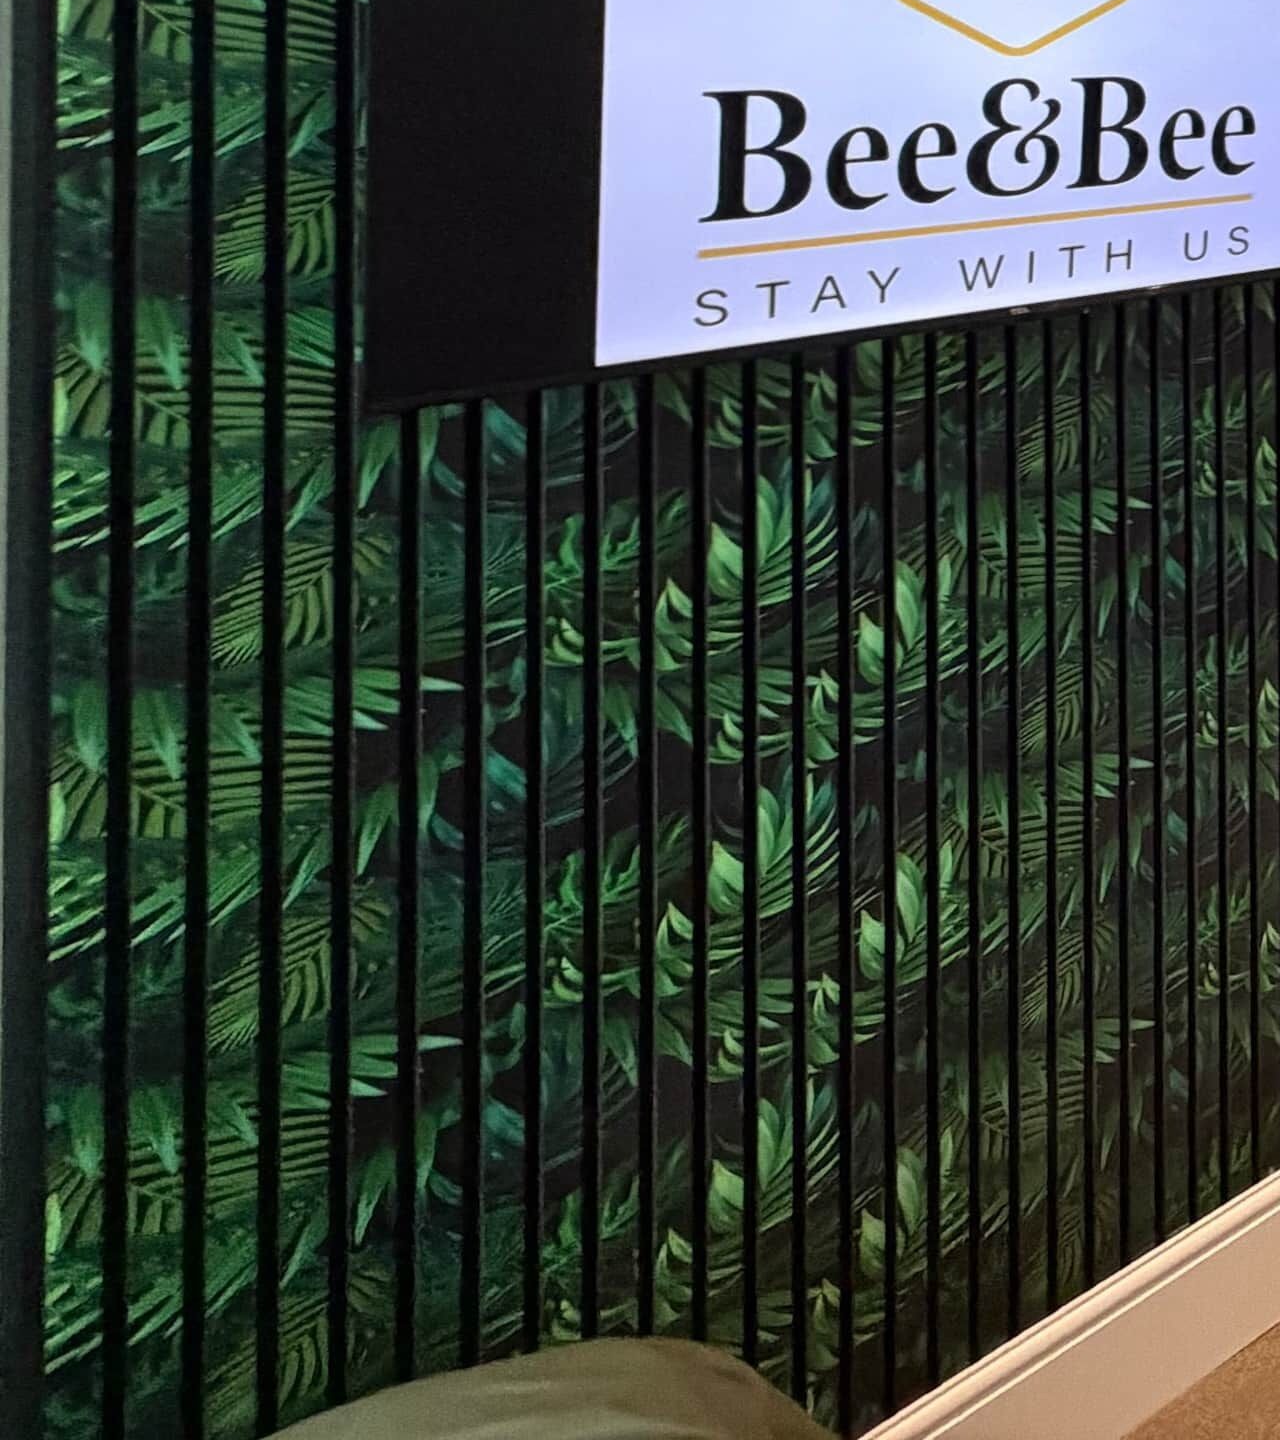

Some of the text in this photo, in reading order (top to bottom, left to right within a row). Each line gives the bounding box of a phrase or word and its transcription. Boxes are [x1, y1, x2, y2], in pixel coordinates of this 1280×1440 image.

[698, 77, 1256, 224] Bee&Bee
[693, 225, 1250, 327] STAY WITH US
